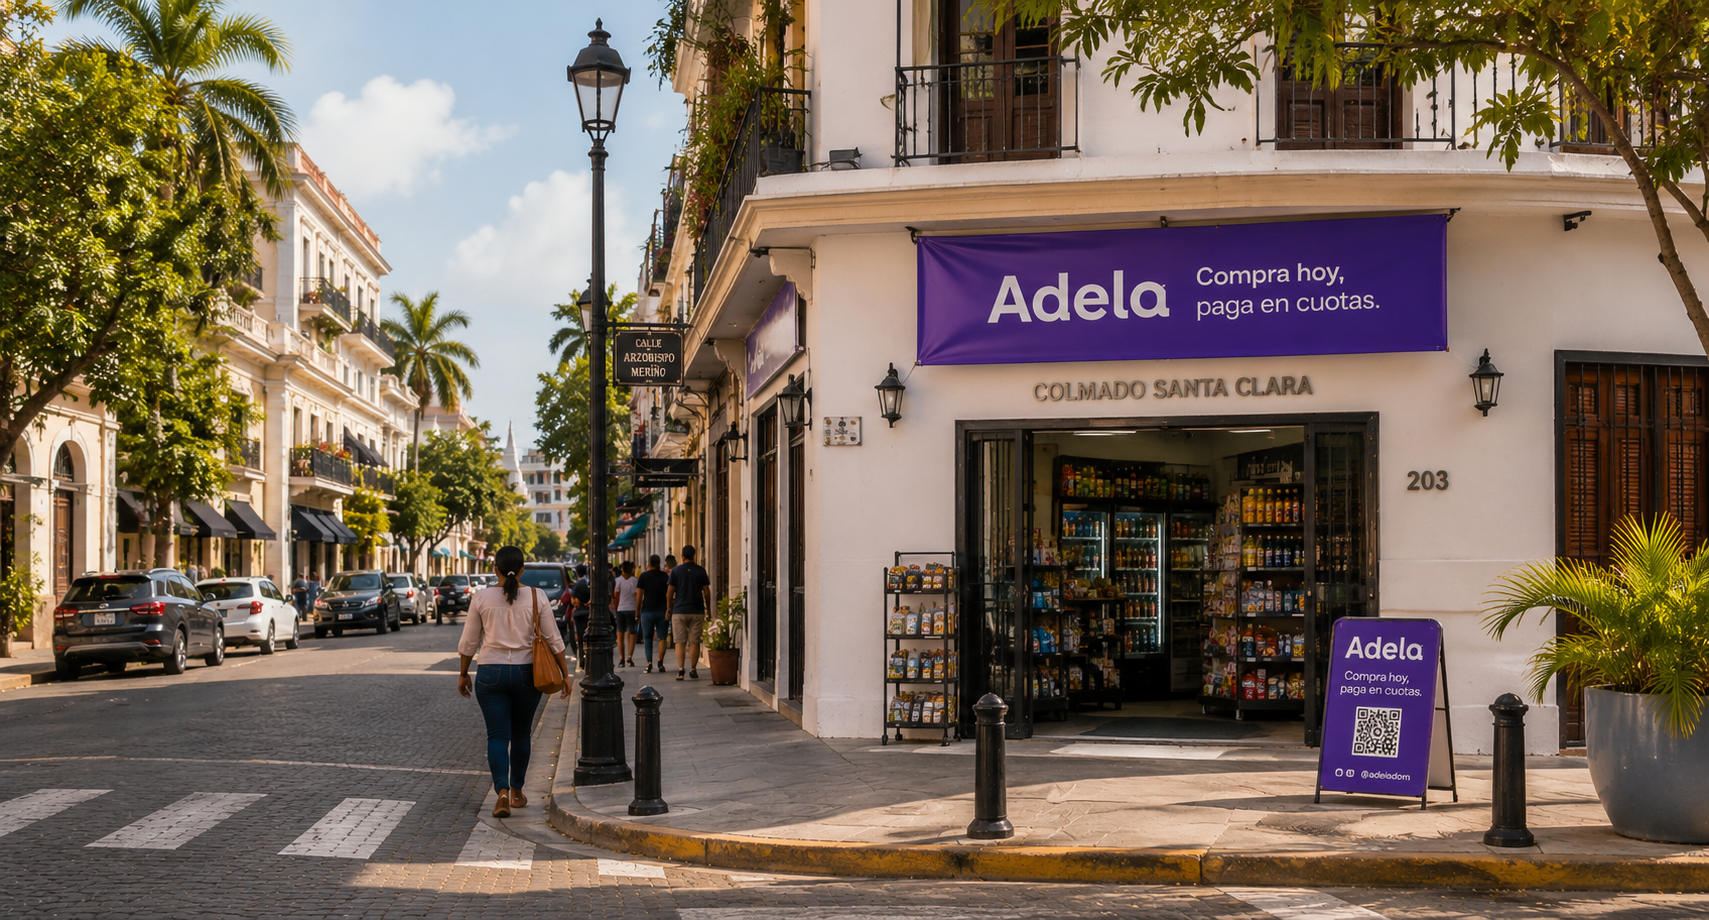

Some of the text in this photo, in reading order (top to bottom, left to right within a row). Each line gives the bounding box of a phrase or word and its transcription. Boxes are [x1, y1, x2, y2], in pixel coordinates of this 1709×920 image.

[1196, 263, 1345, 288] Compra hoy,
[988, 270, 1170, 324] Adela
[1197, 292, 1380, 321] paga en cuotas.
[635, 338, 663, 348] CALLE
[623, 352, 676, 363] ARZOBISPO
[1032, 375, 1314, 402] COLMADO SANTA CLARA
[1407, 470, 1449, 491] 203
[1344, 636, 1424, 661] Adela
[1344, 670, 1410, 685] Compra hoy,
[1339, 685, 1422, 697] paga en cuotas.
